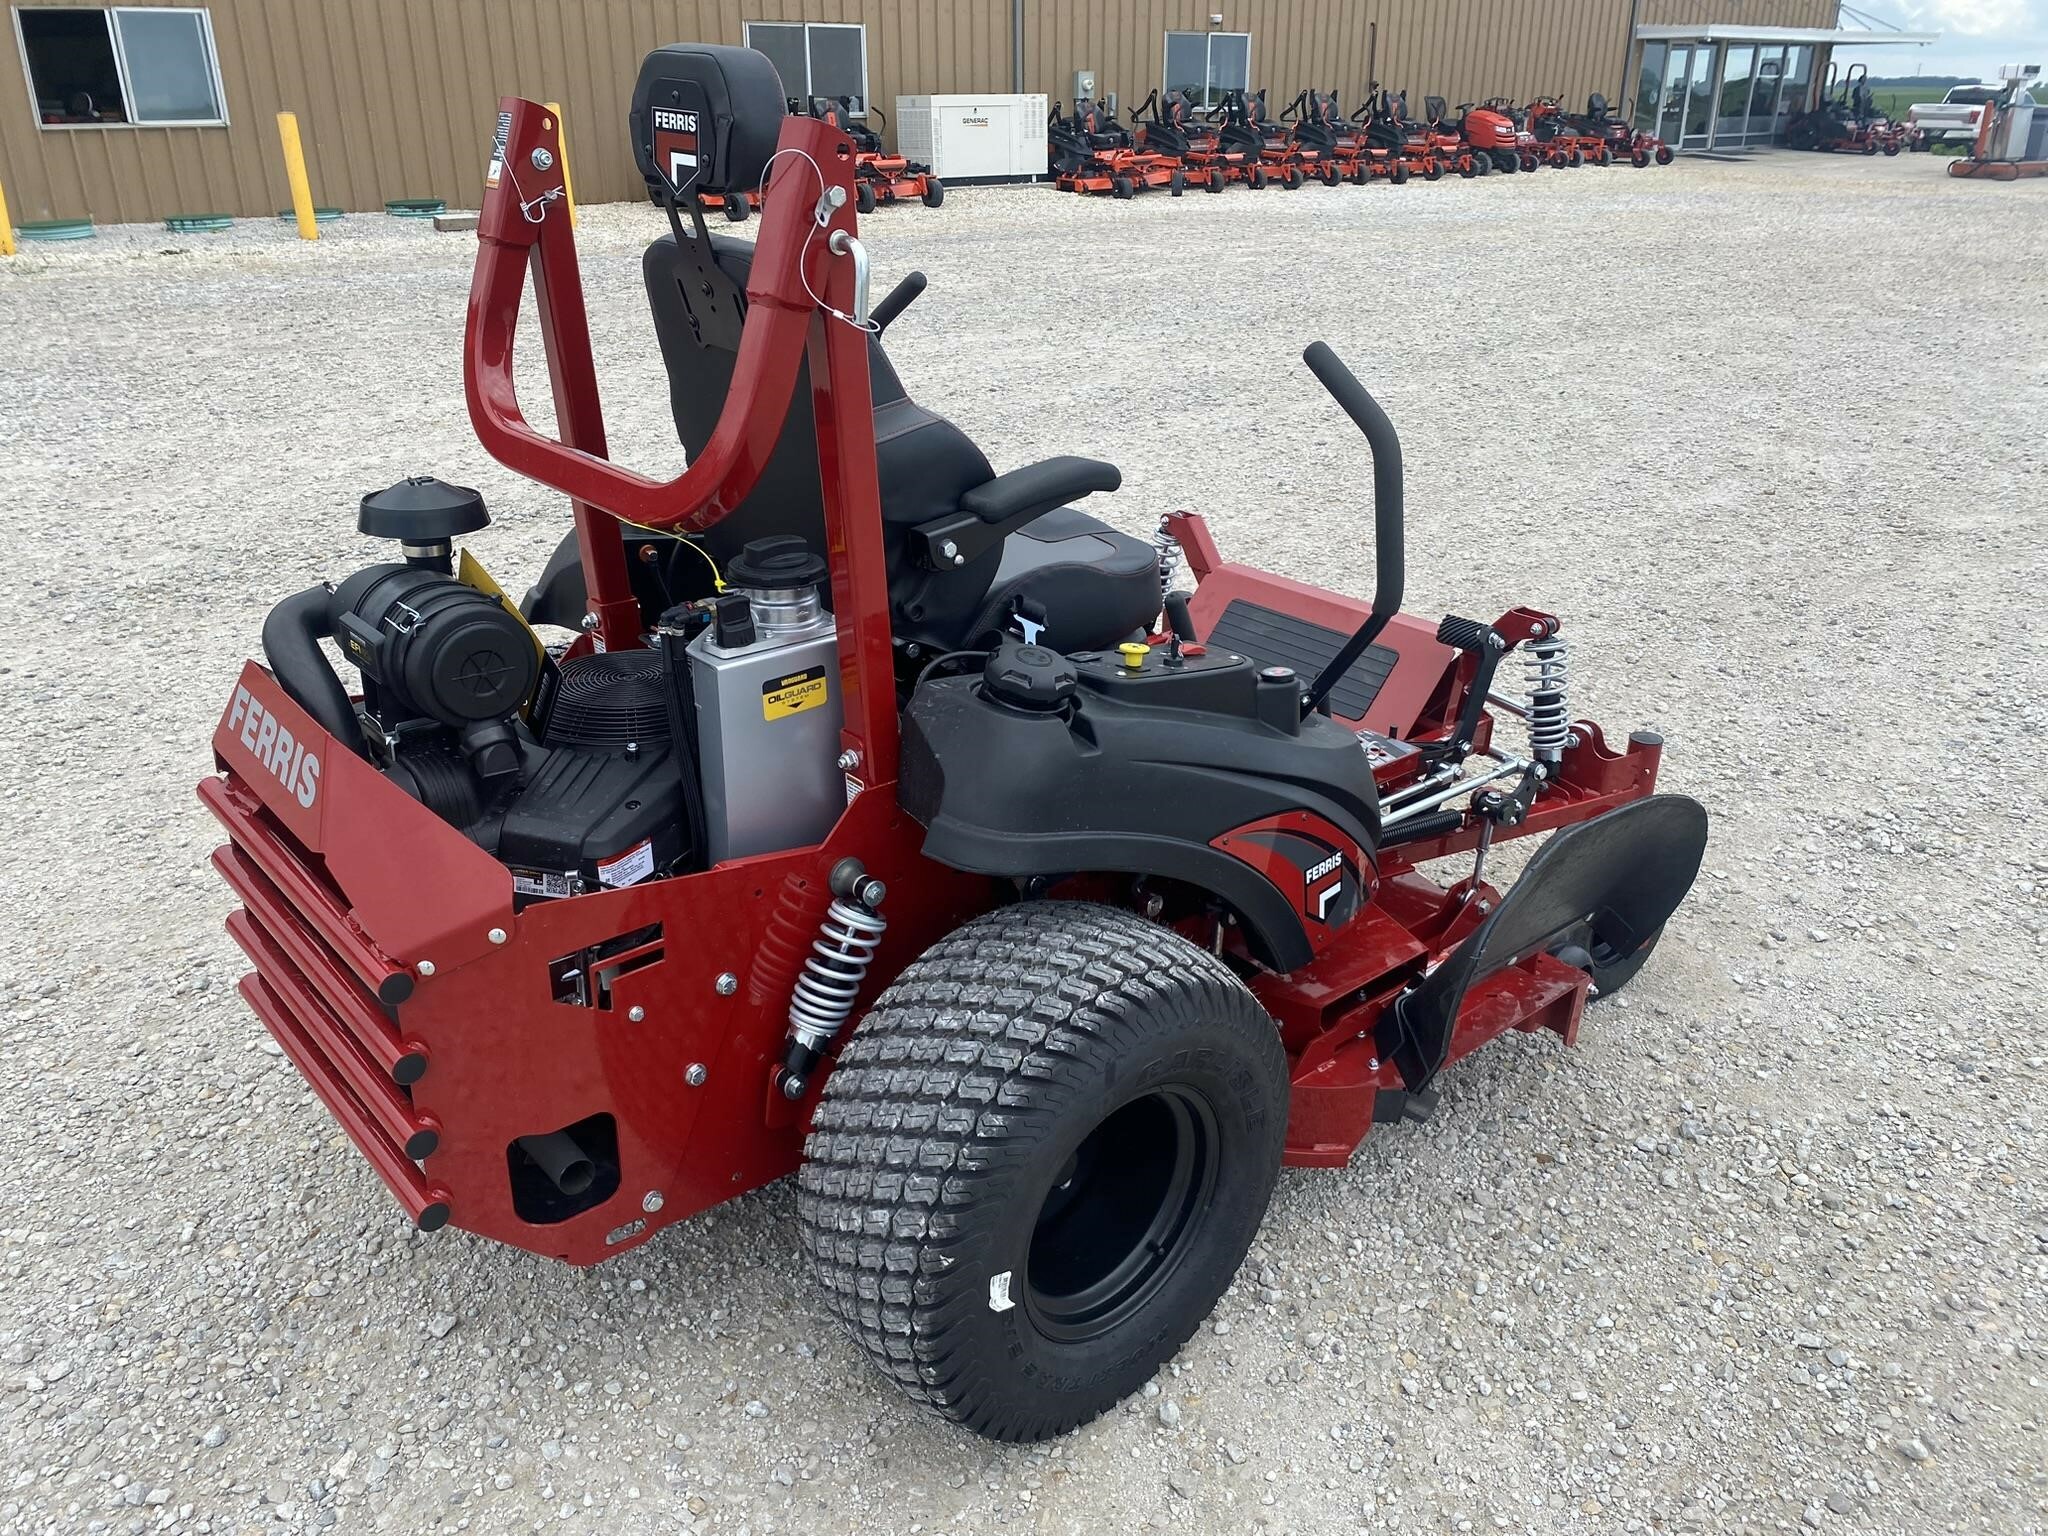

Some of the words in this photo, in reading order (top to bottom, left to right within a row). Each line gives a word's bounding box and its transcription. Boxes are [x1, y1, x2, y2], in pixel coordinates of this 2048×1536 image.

[655, 111, 697, 132] FERRIS
[768, 682, 822, 704] OILGUARD
[228, 683, 320, 809] FERRIS
[1306, 851, 1343, 885] FERRIS
